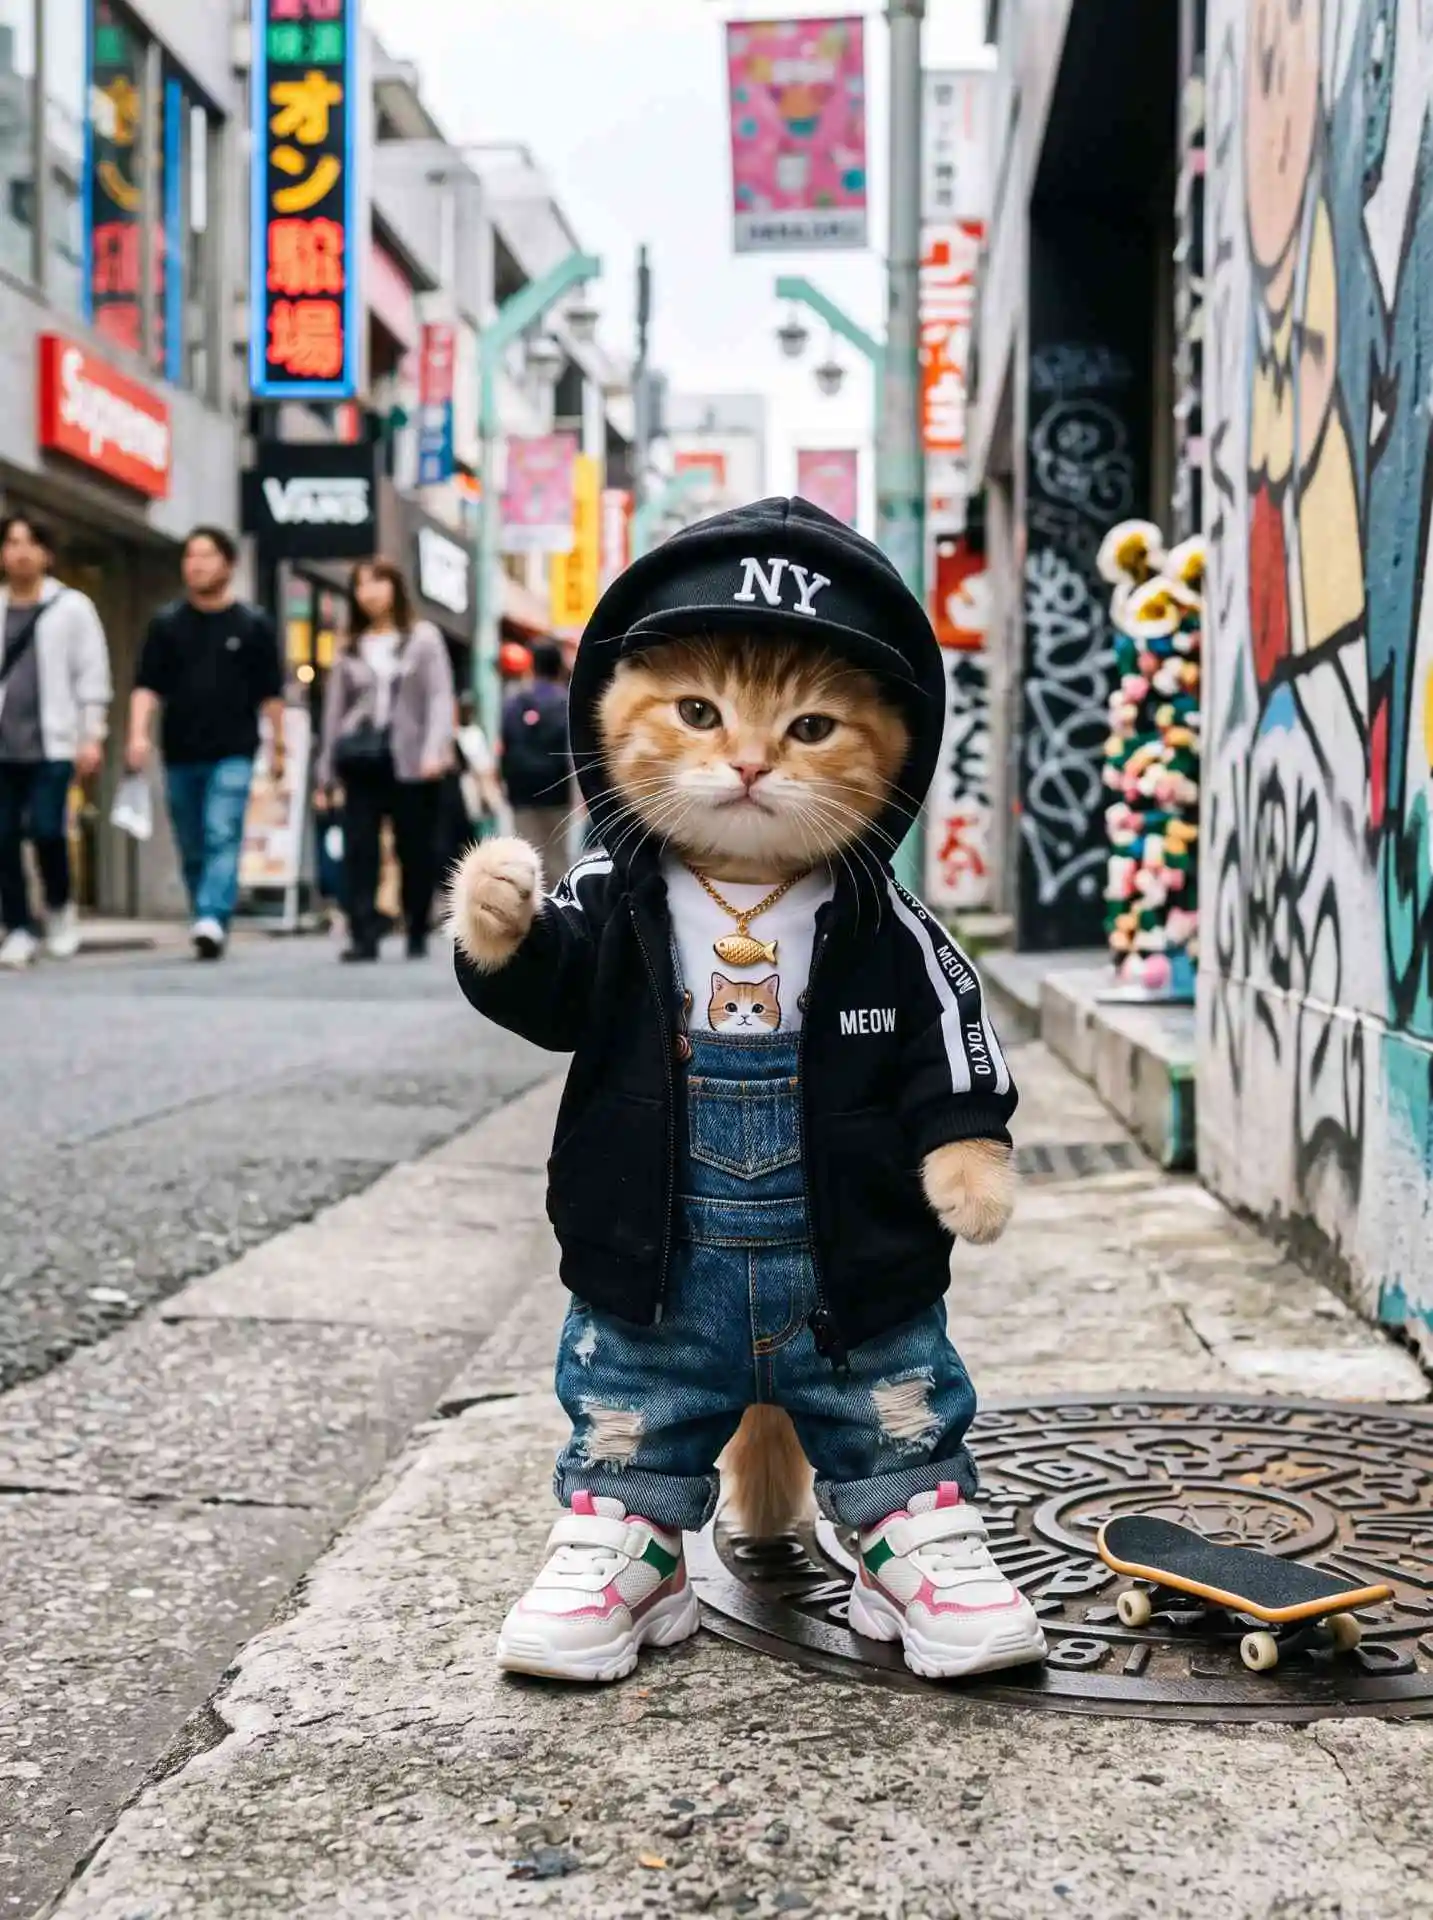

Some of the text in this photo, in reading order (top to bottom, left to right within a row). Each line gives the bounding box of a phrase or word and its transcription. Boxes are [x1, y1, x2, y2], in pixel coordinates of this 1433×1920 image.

[733, 556, 832, 617] NY
[936, 944, 977, 995] MEOW
[839, 1007, 897, 1036] MEOW
[965, 1020, 992, 1077] TOKYO
